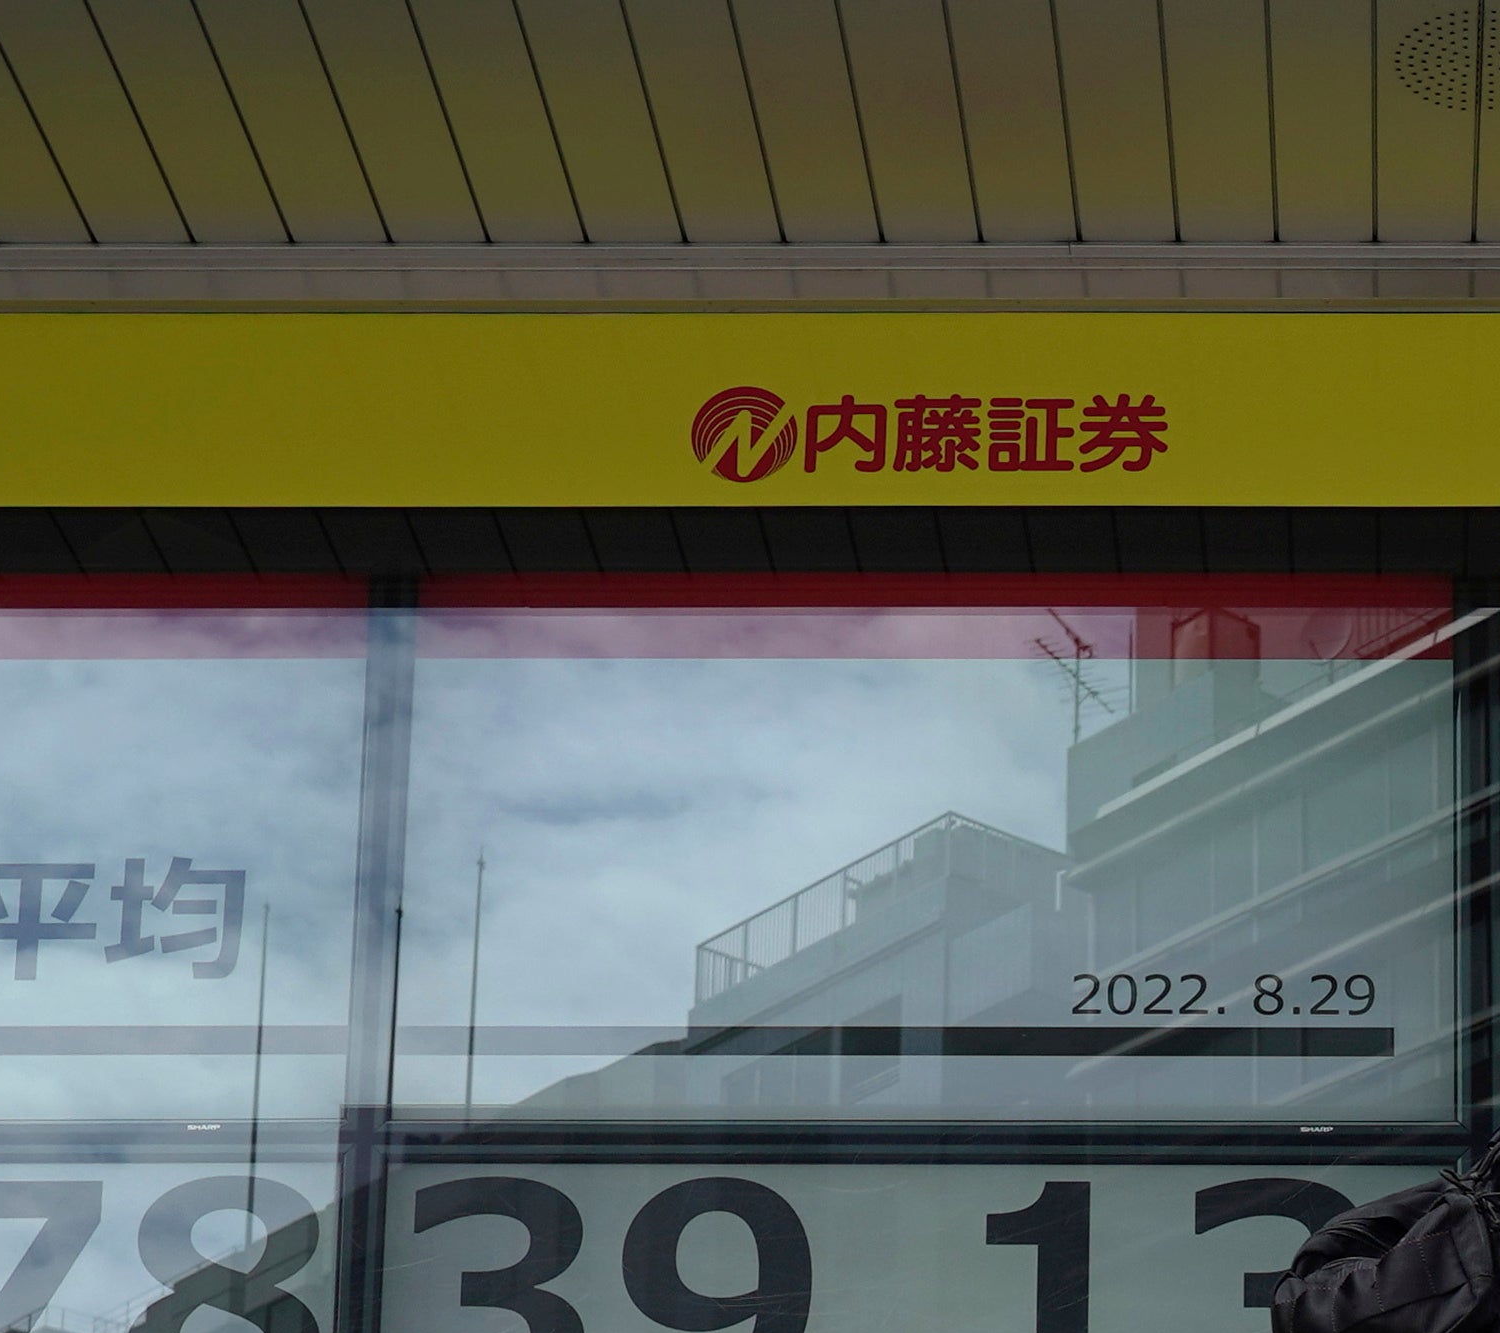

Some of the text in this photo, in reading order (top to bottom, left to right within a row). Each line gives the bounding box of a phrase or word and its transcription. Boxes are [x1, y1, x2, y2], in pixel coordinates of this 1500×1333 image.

[804, 395, 1168, 473] 内藤証券
[1072, 973, 1376, 1015] 2022. 8.29
